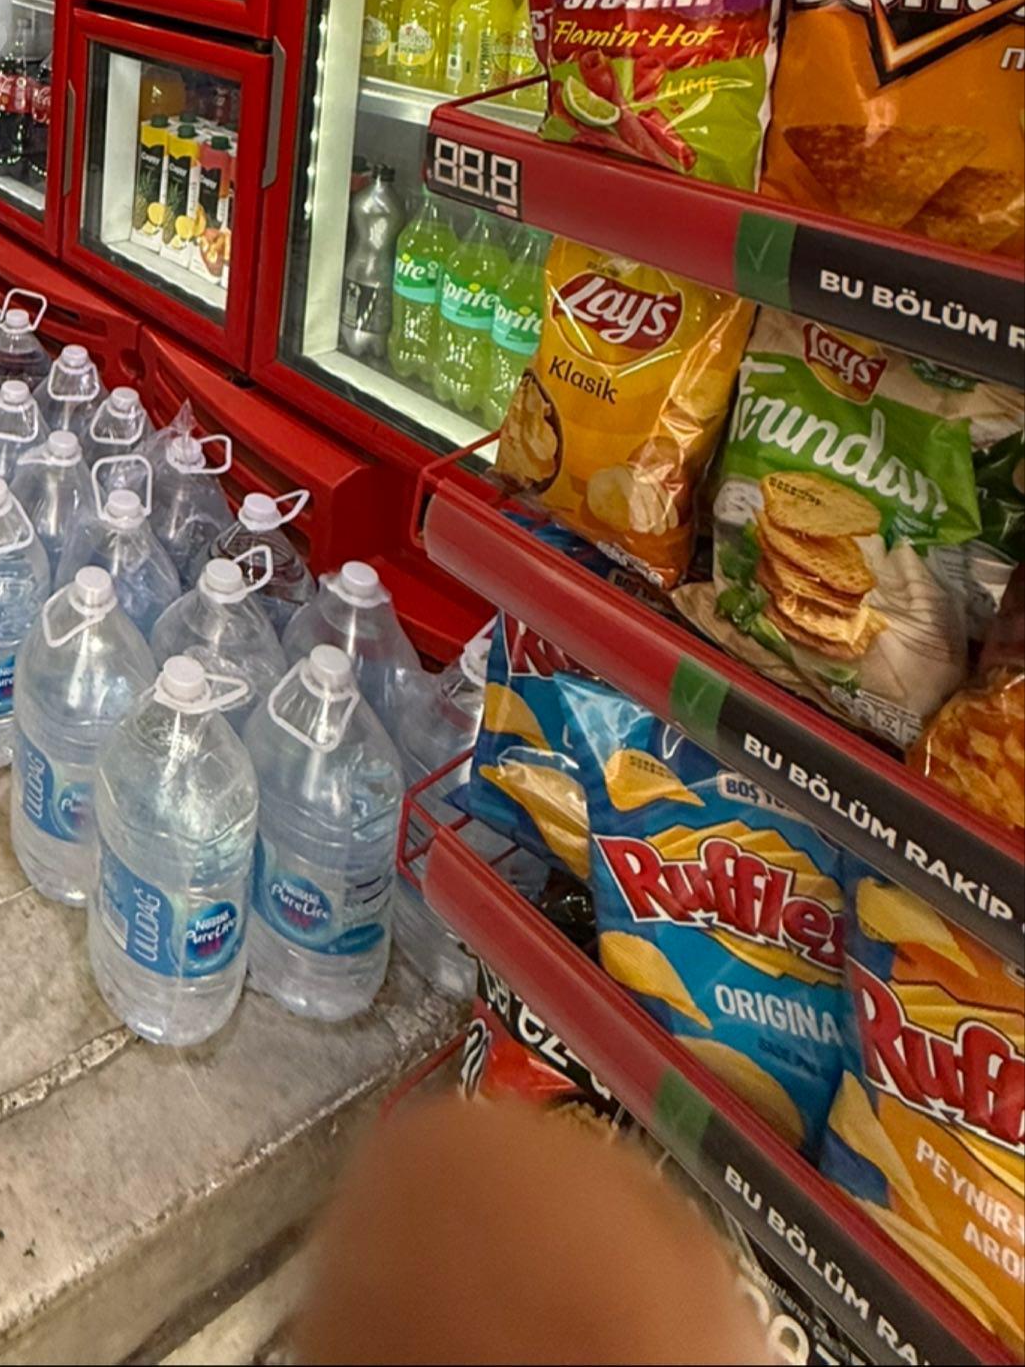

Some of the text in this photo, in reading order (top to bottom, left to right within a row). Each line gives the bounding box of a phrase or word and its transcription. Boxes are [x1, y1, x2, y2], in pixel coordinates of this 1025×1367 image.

[649, 23, 724, 48] Hot
[494, 302, 543, 335] prite
[568, 275, 678, 345] Lay's
[820, 269, 866, 300] BU
[872, 277, 997, 338] BÖLÜM
[548, 355, 619, 405] Klasik
[743, 732, 1015, 925] BU BÖLÜM RAKİP
[714, 983, 843, 1046] ORIGINA
[846, 956, 1025, 1154] Ruff
[724, 1164, 763, 1211] BU
[766, 1205, 871, 1322] BÖLÜM
